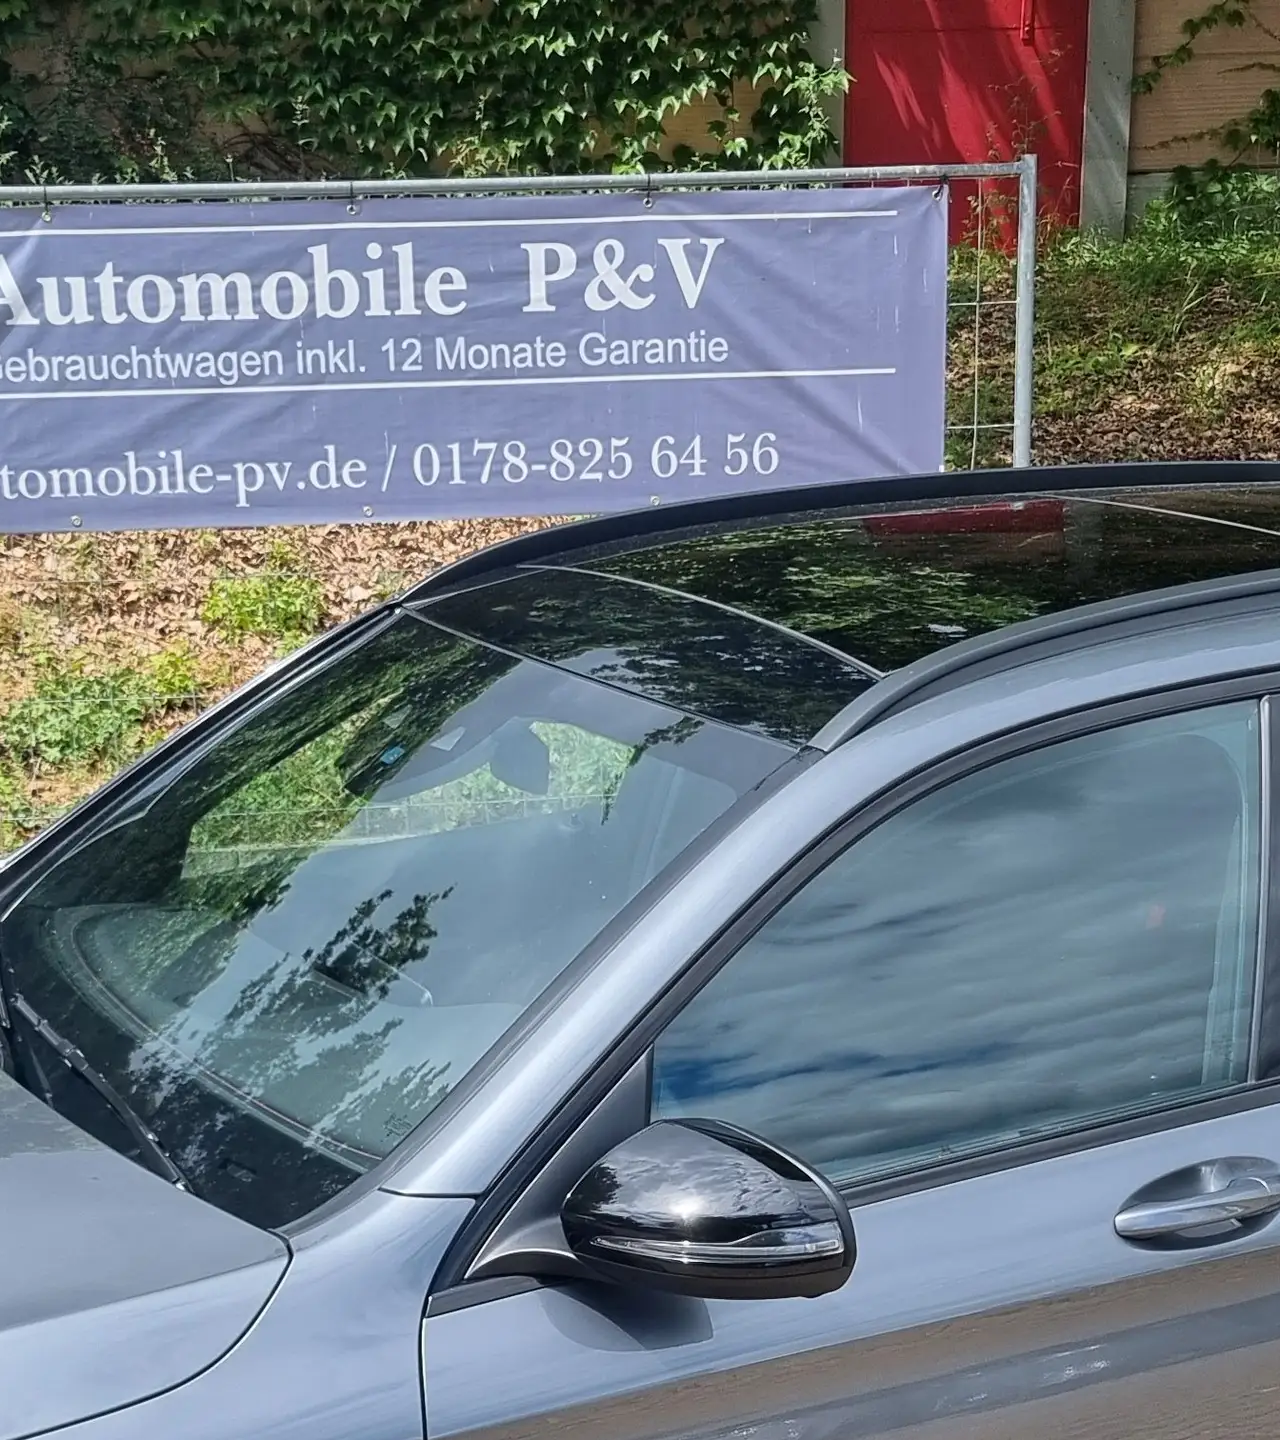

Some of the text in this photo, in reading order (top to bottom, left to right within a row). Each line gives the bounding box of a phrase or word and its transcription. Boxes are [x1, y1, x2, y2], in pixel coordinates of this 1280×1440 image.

[520, 237, 725, 313] P&V
[295, 339, 367, 375] inkl.
[381, 338, 423, 372] 12
[435, 335, 567, 371] Monate
[578, 329, 729, 366] Garantie
[381, 444, 398, 493] /
[412, 437, 633, 487] 0178-825
[650, 434, 708, 478] 64
[723, 432, 780, 475] 56
